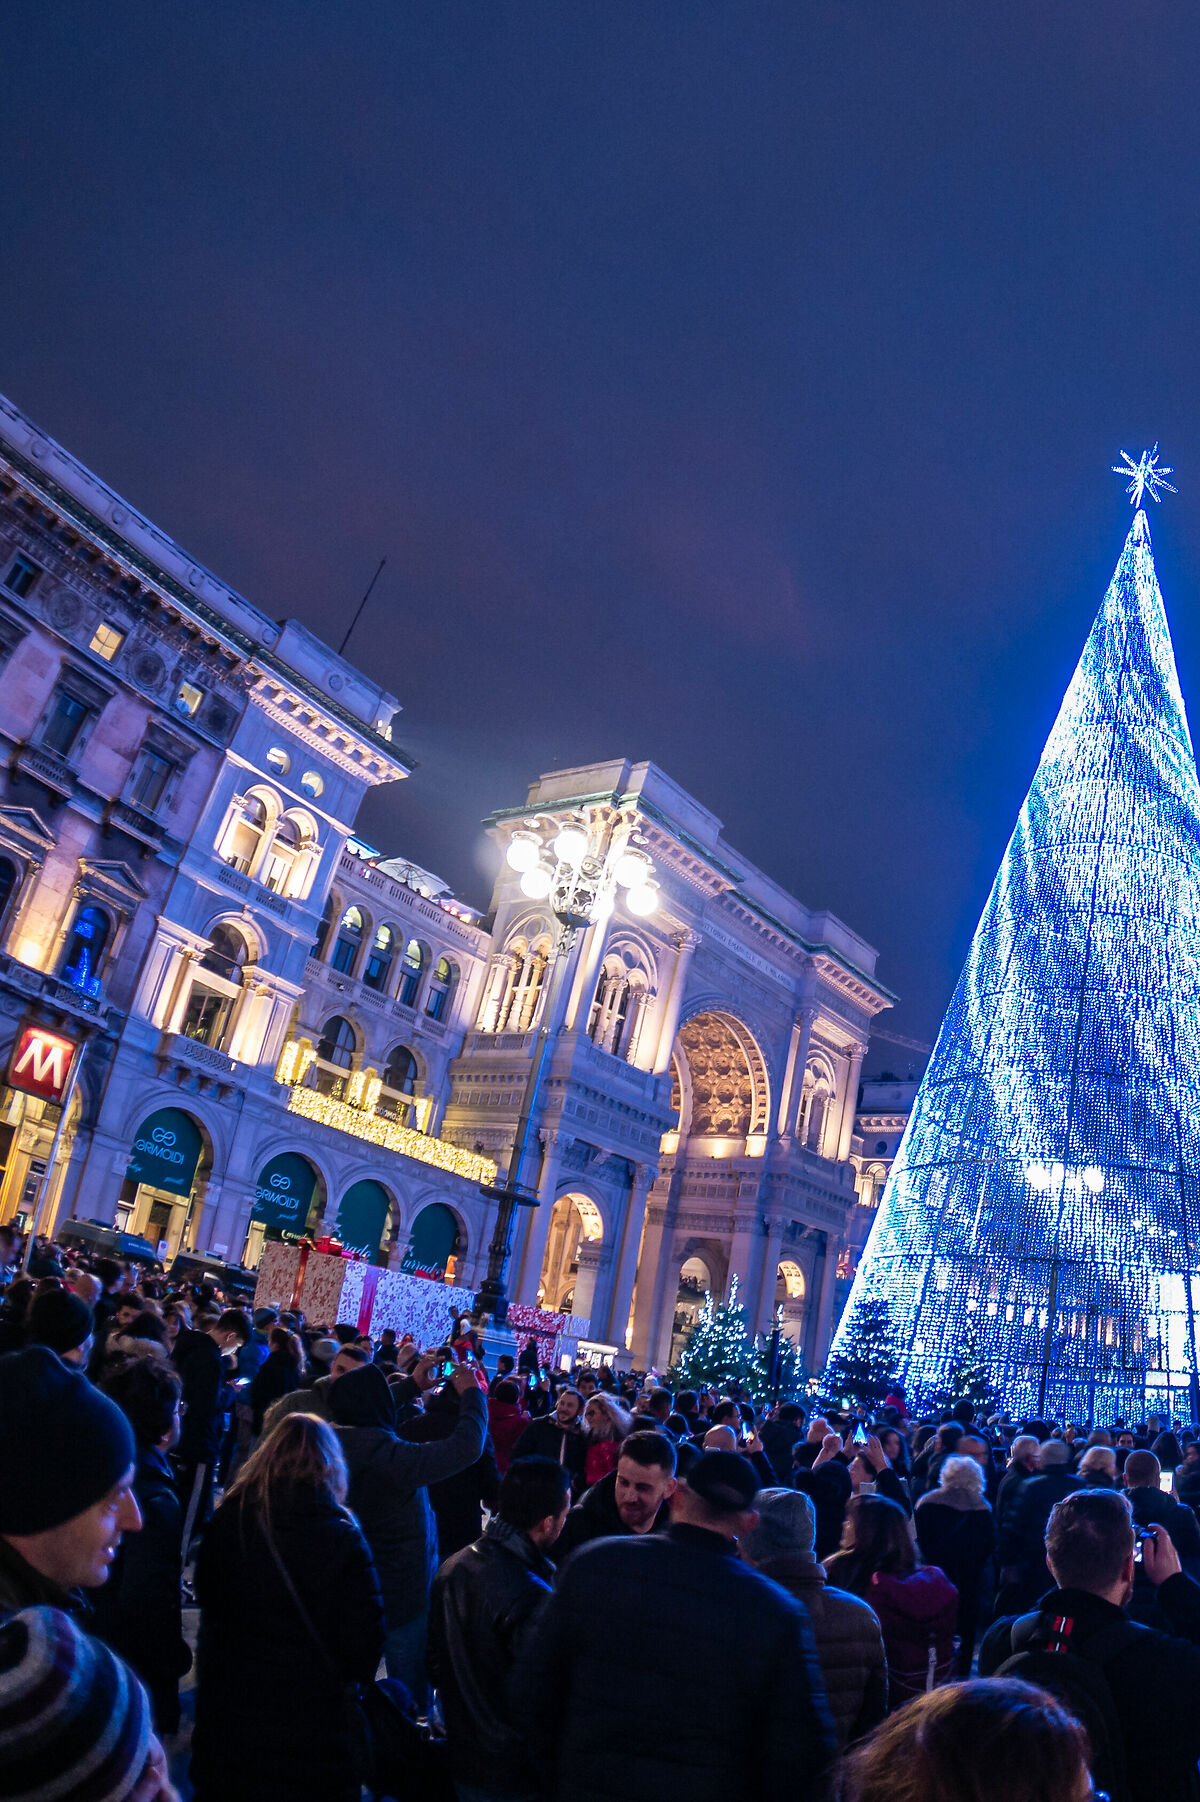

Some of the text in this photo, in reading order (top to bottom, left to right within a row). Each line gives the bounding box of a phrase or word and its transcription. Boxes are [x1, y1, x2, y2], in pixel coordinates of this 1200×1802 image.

[14, 1038, 64, 1090] M
[135, 1139, 185, 1165] GRIMOLDI
[255, 1188, 300, 1210] GRIMOLDI
